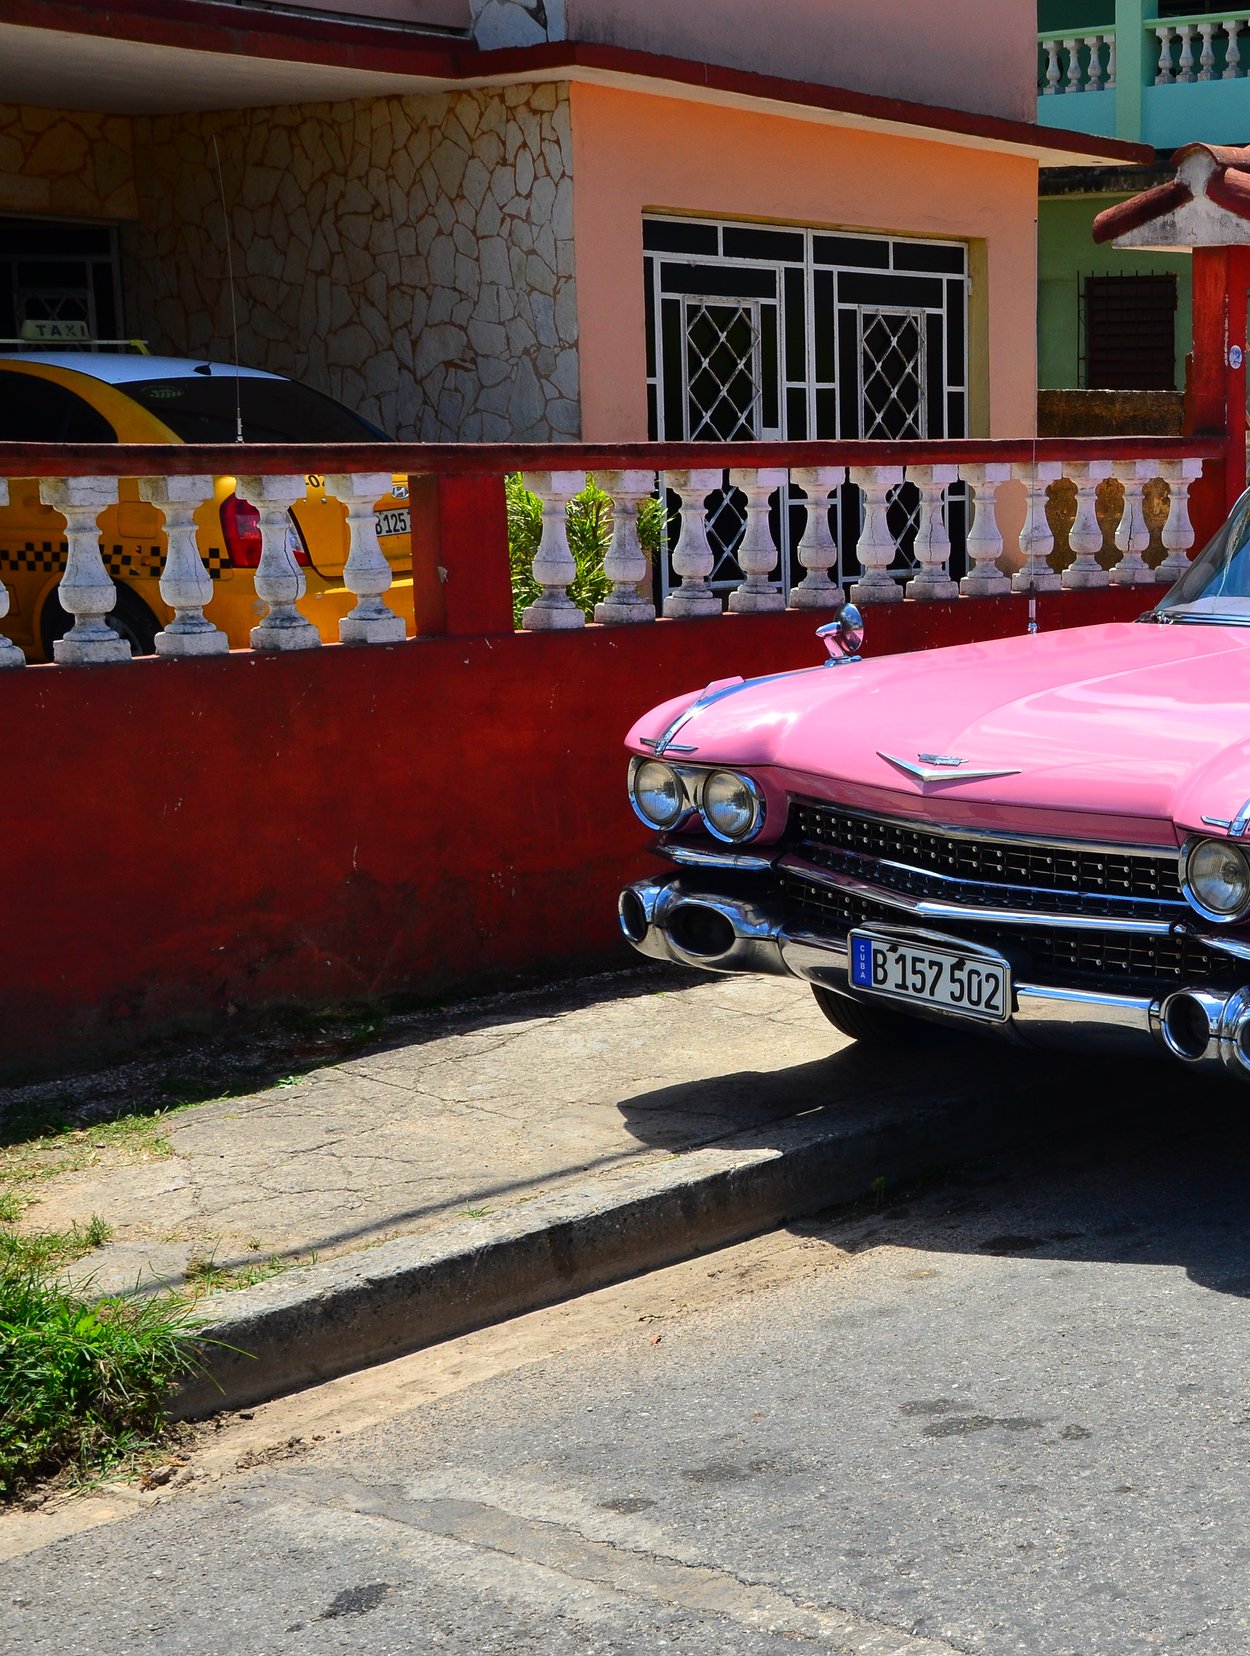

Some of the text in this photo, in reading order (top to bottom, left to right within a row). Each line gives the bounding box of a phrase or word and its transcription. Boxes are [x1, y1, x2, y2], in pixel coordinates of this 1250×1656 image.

[35, 324, 86, 337] TAXI
[384, 512, 407, 533] 125
[873, 948, 1000, 1012] B 157 502
